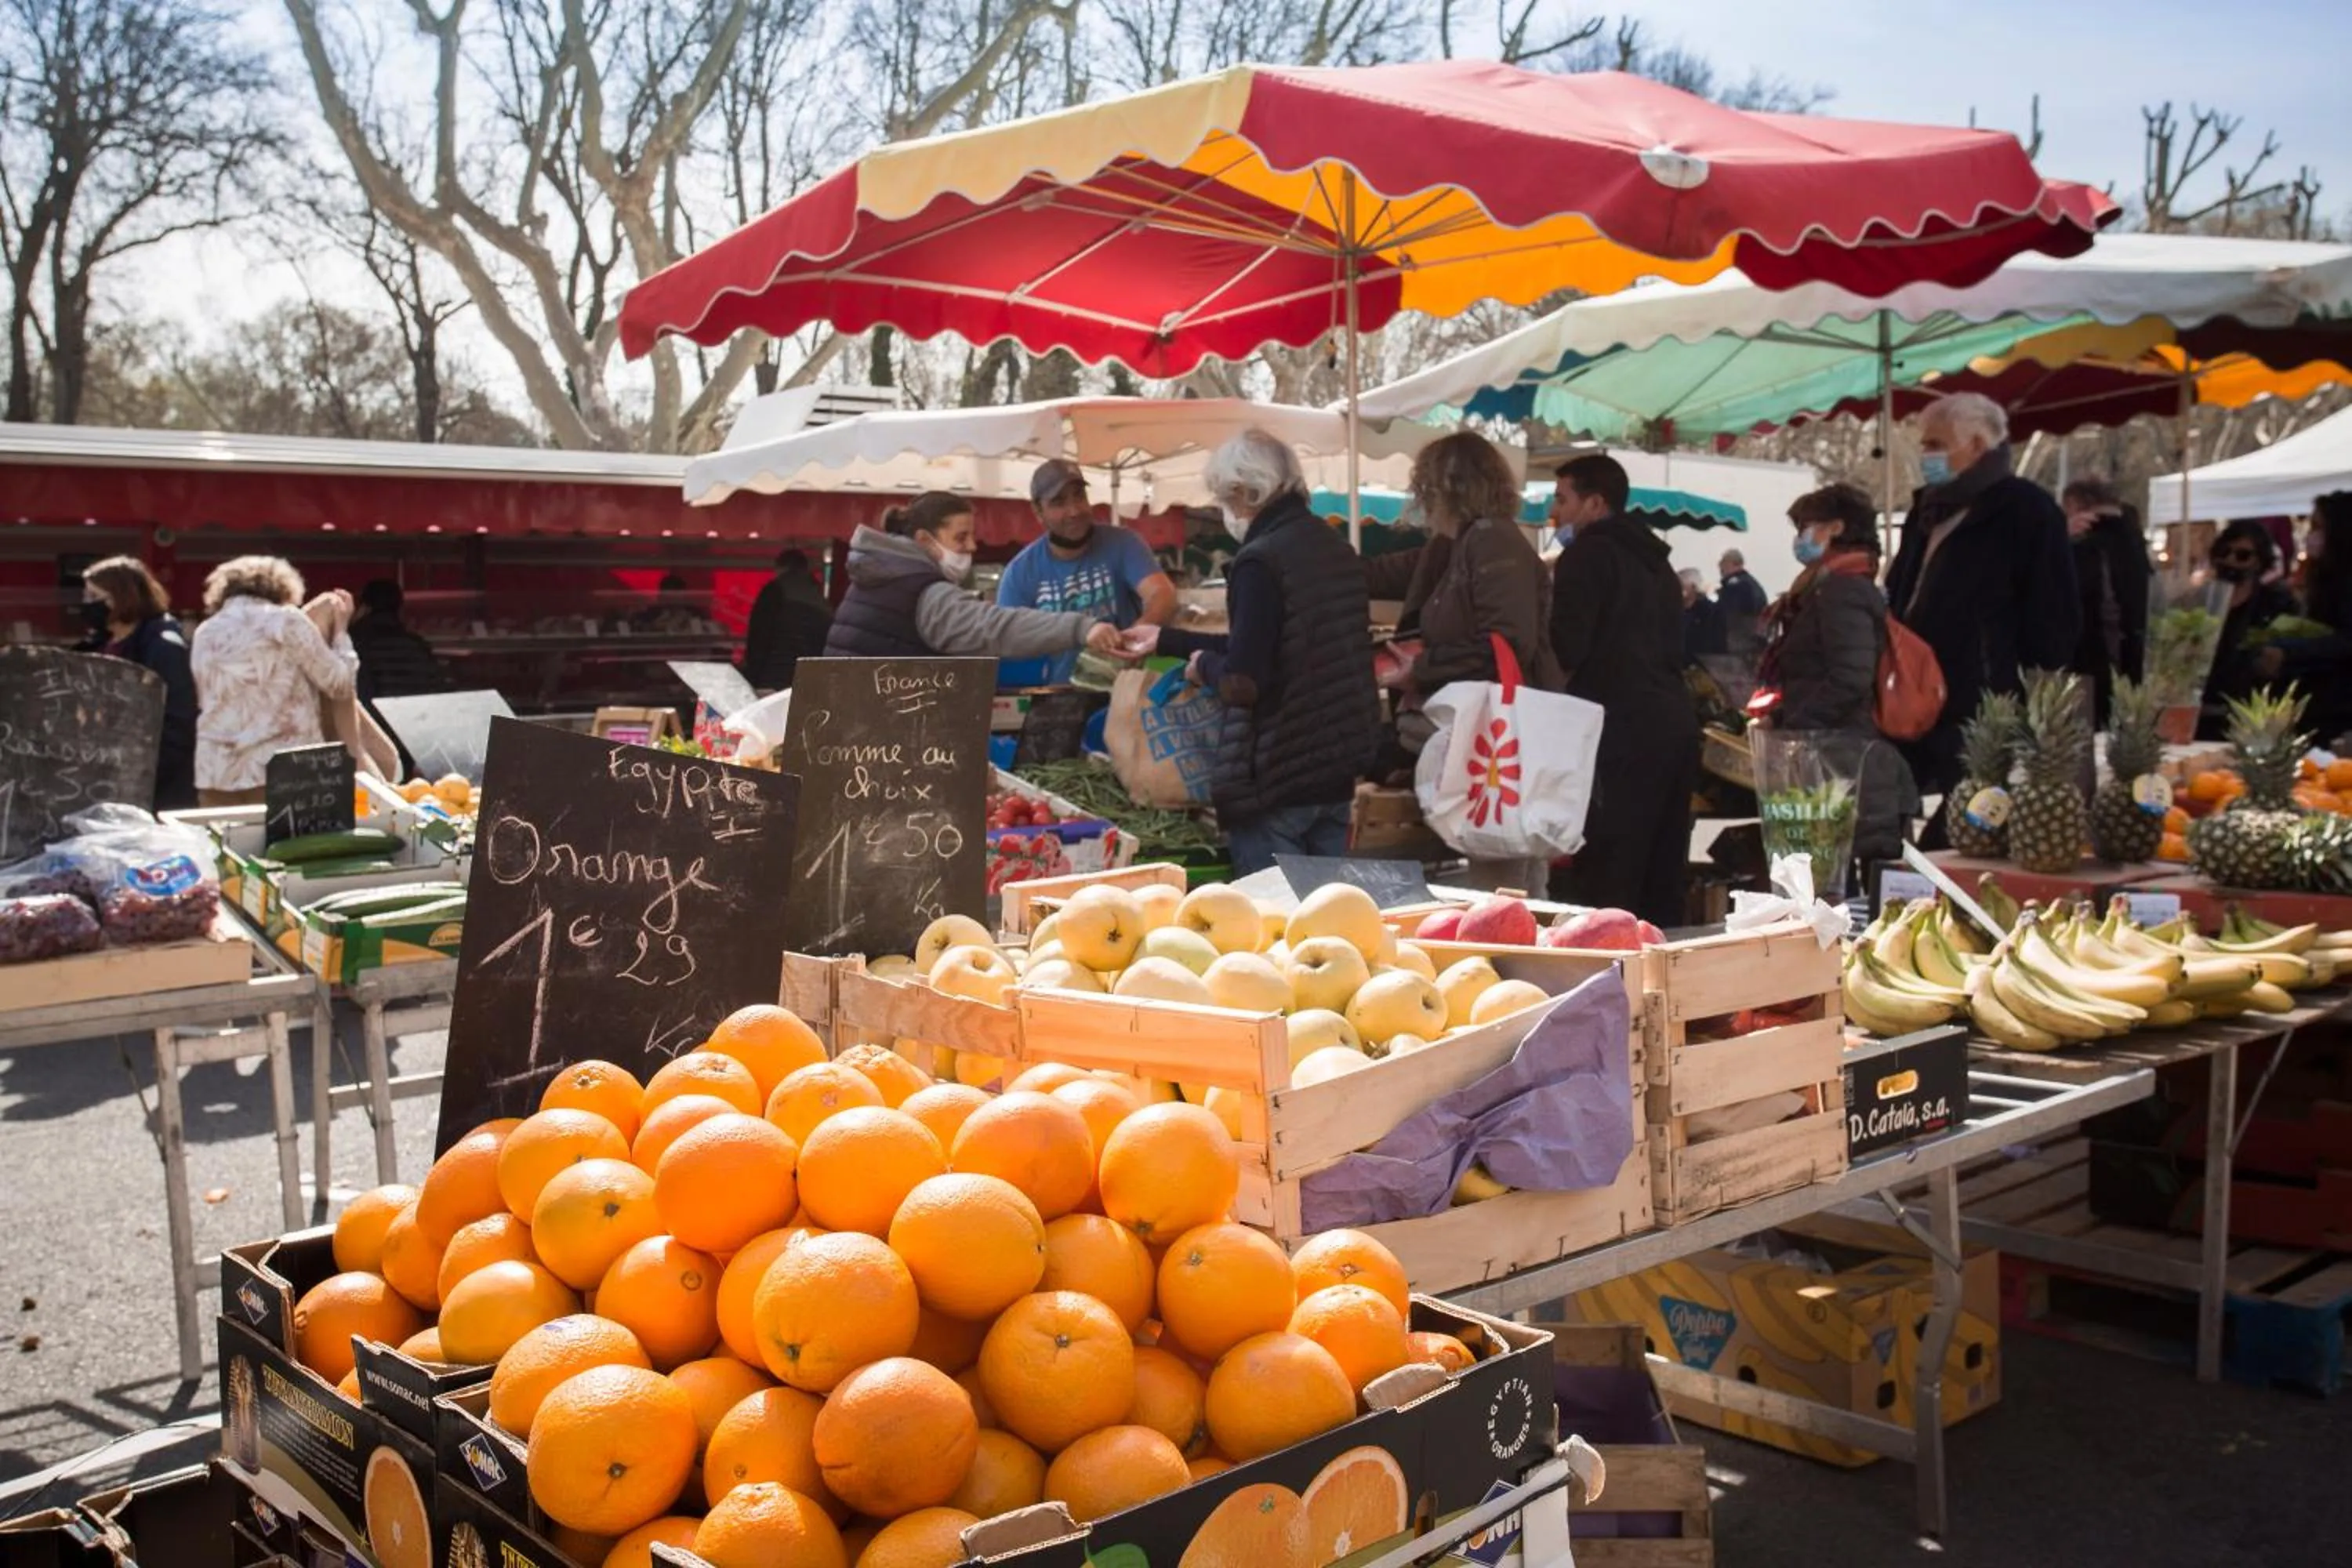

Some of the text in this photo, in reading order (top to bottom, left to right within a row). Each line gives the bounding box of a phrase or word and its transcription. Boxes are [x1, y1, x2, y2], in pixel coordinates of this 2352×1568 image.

[873, 664, 955, 695] France
[801, 709, 955, 766] Pomme au
[488, 815, 722, 935] Orange
[1487, 1377, 1534, 1431] EGYPTIAN
[1490, 1422, 1530, 1459] ORANGES
[1449, 1507, 1522, 1556] SONA
